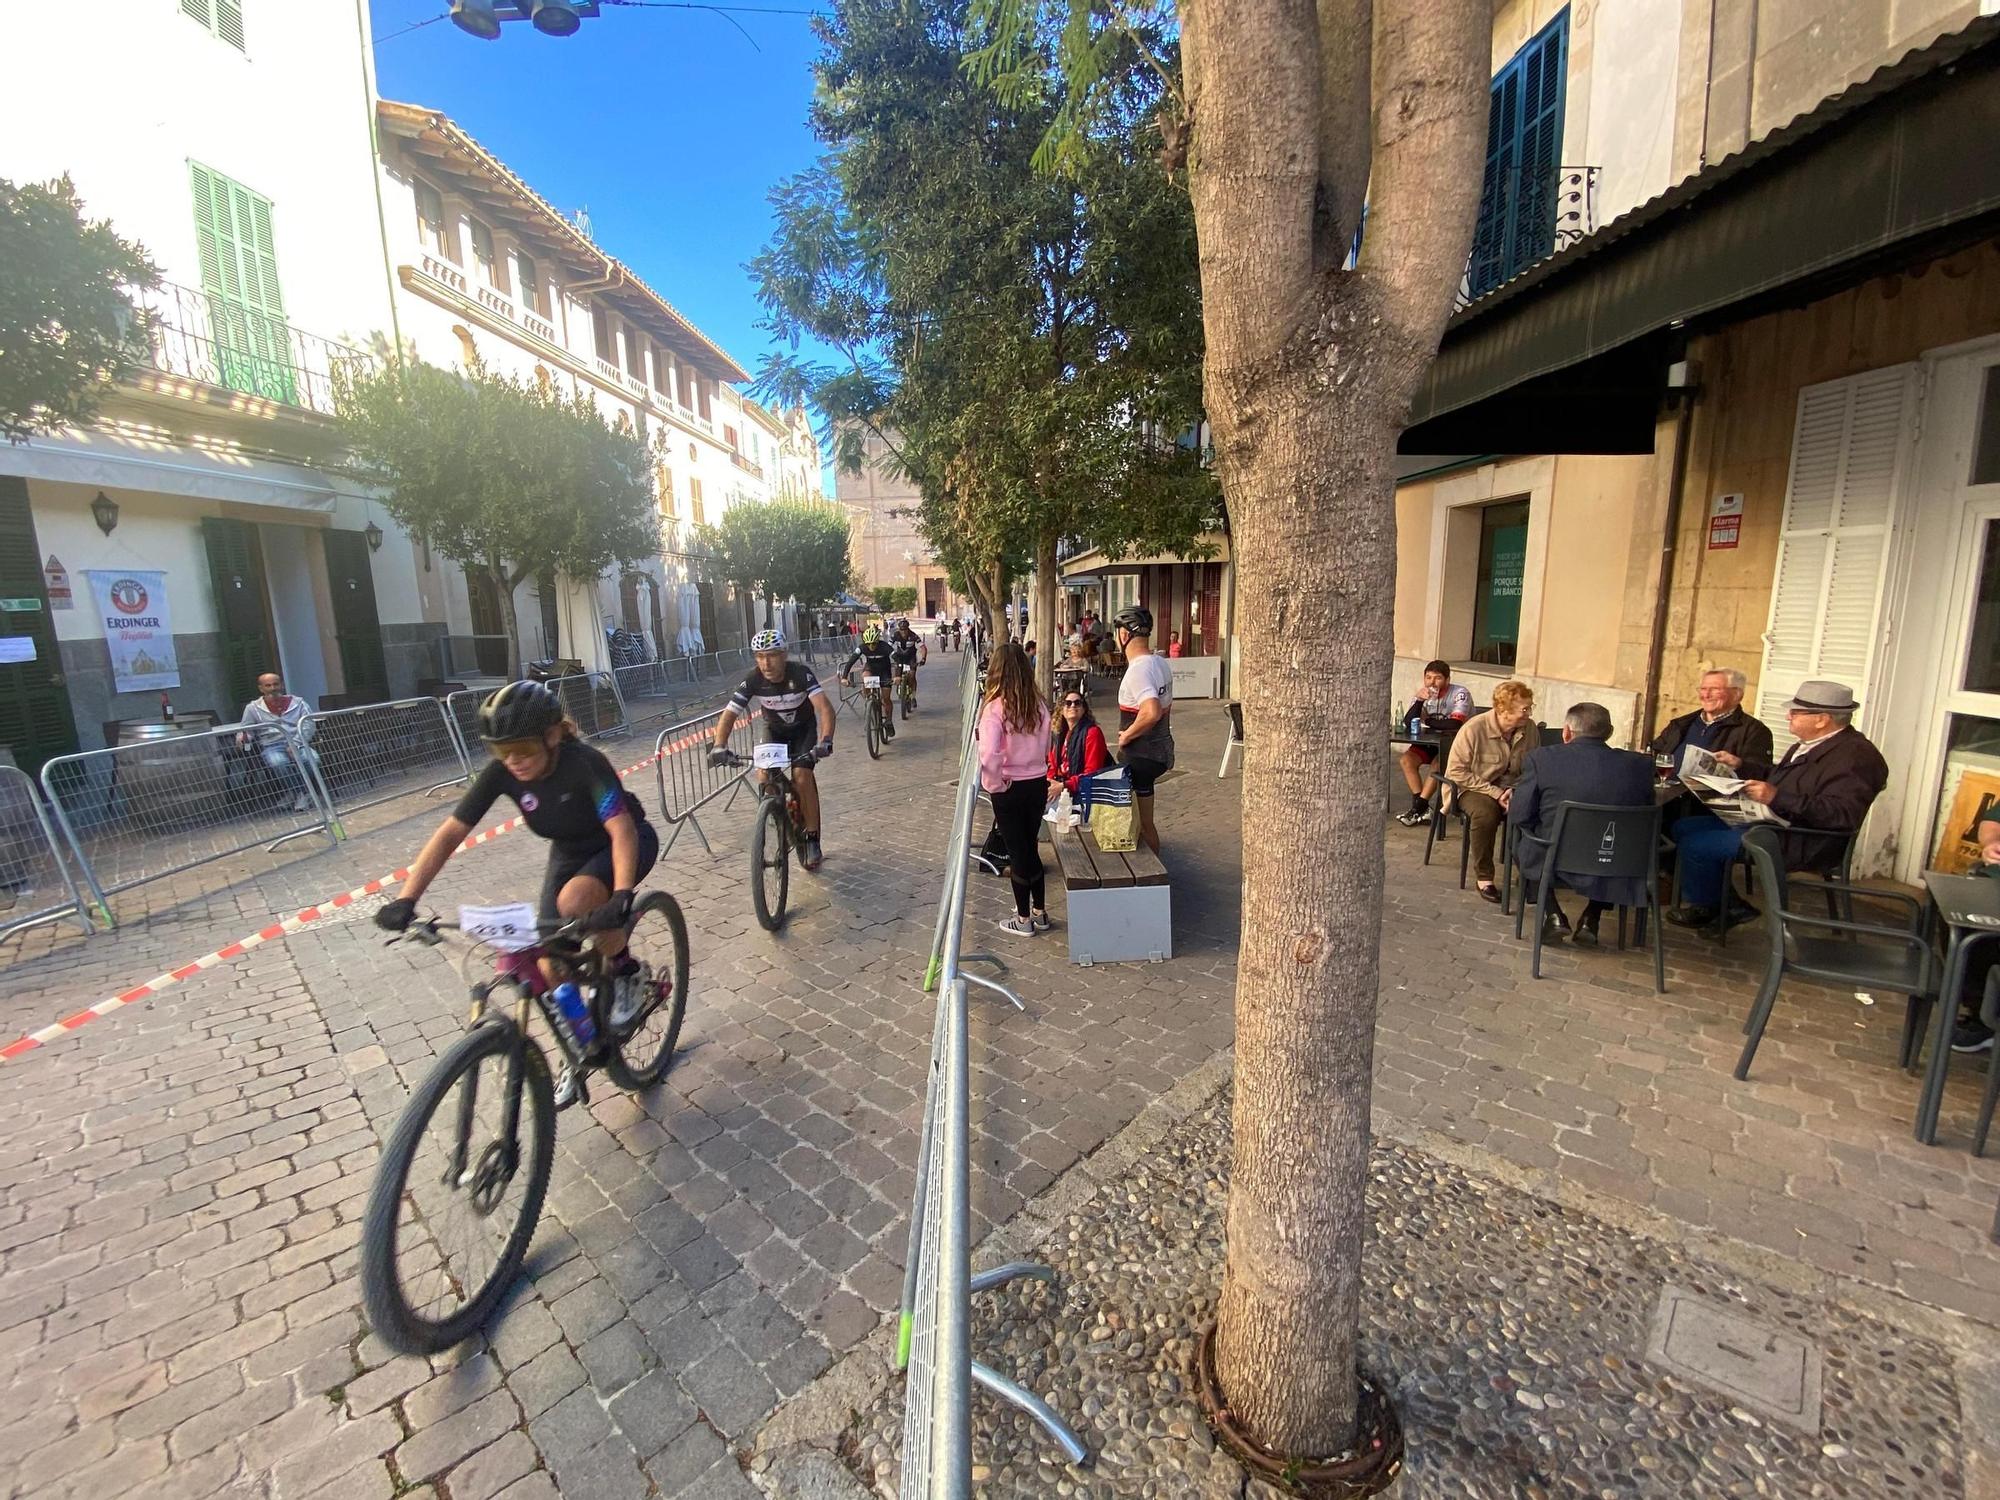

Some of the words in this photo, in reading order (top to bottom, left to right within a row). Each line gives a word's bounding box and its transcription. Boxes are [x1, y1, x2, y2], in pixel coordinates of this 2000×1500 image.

[1713, 518, 1739, 526] Alarma
[1494, 577, 1517, 587] PORQUE
[1493, 588, 1502, 596] UN
[1503, 588, 1522, 596] BANCO
[106, 617, 160, 629] ERDINGER
